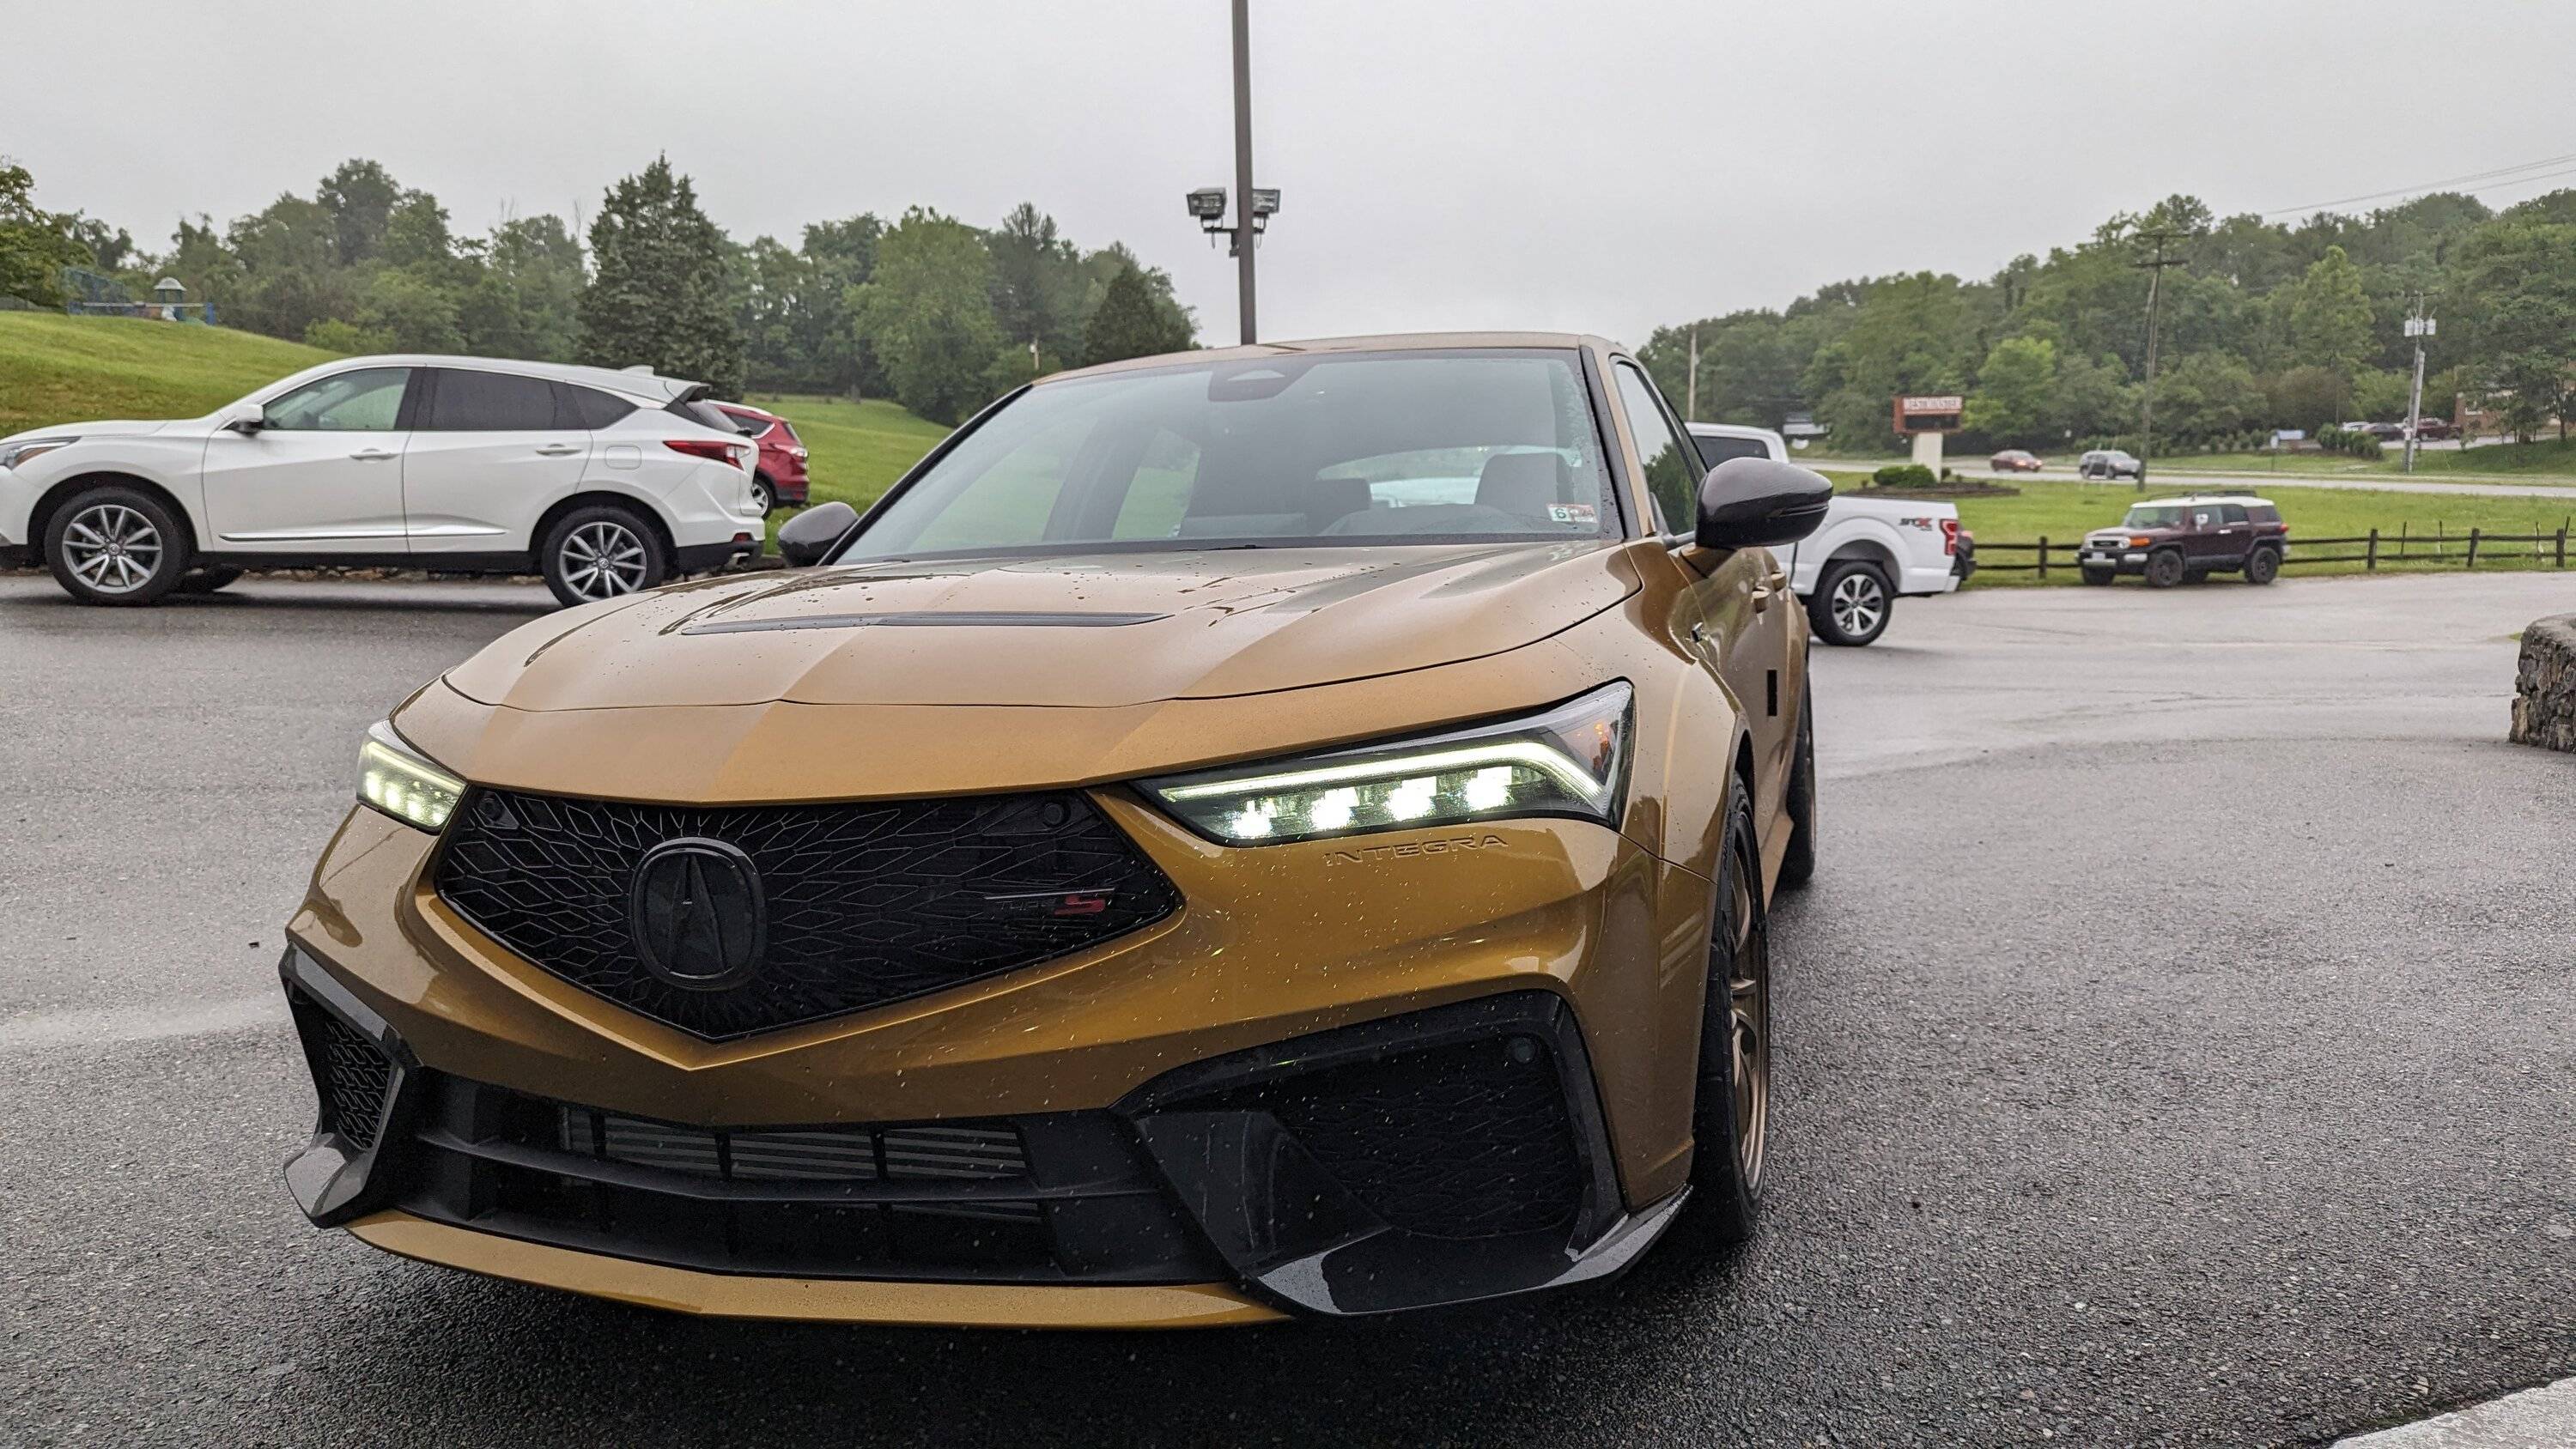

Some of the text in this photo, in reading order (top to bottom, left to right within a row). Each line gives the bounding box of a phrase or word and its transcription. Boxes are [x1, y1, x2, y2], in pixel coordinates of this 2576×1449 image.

[1554, 507, 1566, 518] 6
[1323, 835, 1509, 866] INTEGRA
[1054, 894, 1106, 917] S
